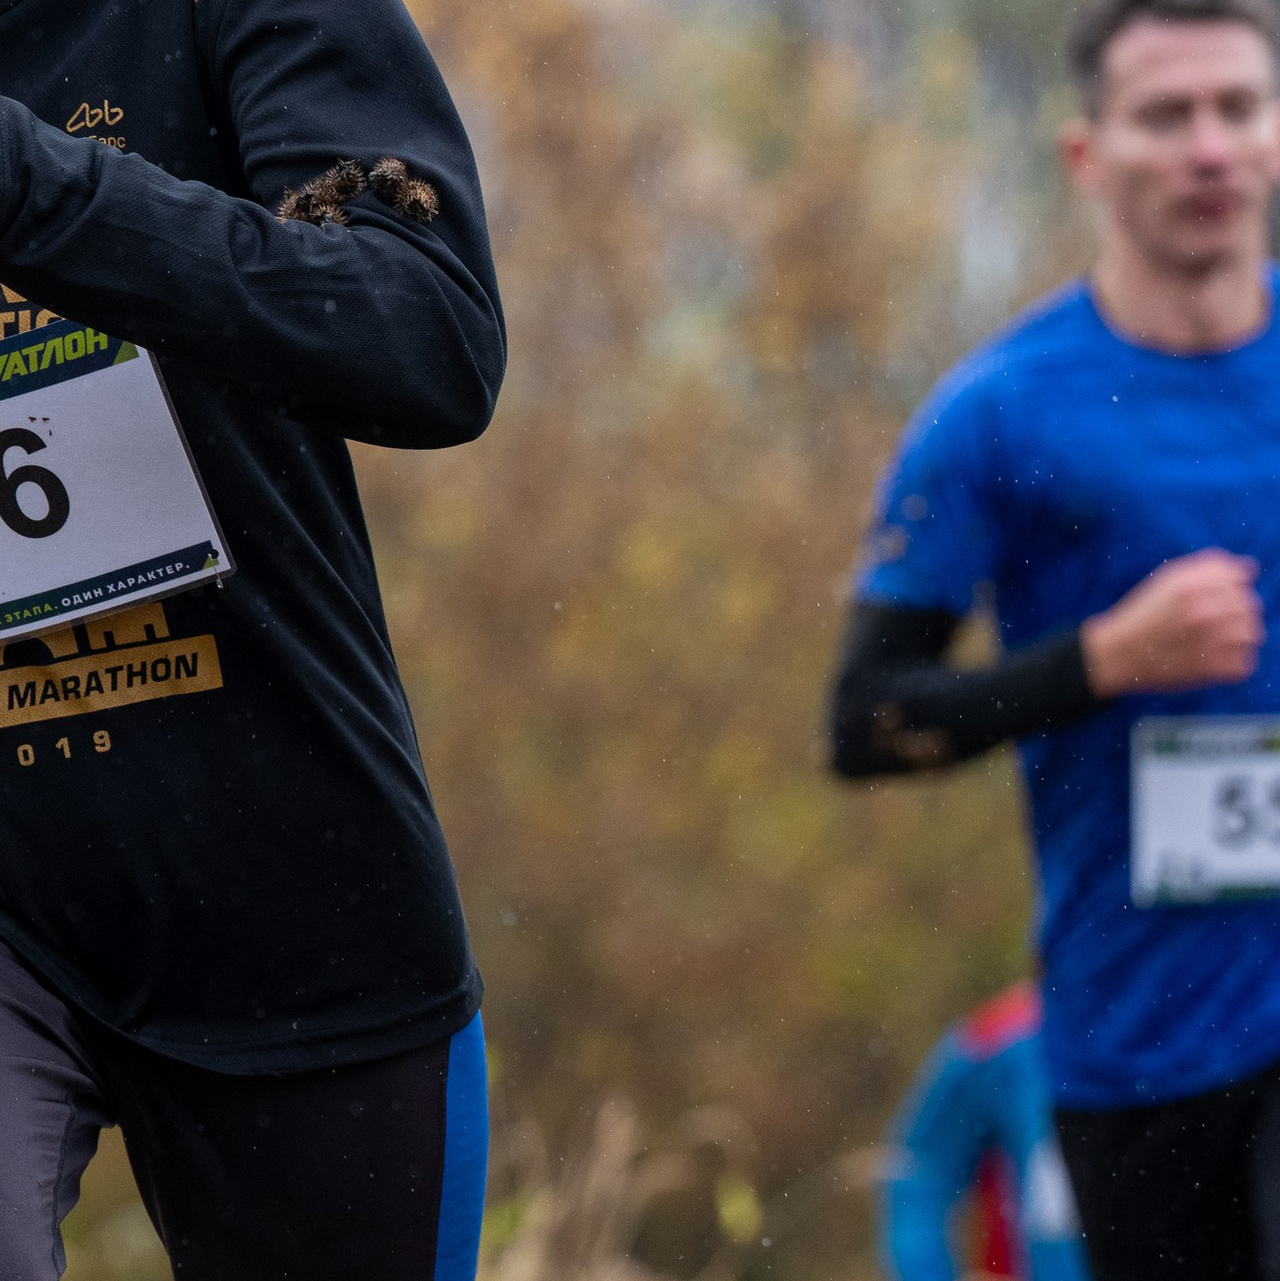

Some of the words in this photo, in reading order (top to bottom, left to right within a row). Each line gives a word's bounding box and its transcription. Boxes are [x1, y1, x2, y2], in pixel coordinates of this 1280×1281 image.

[4, 603, 59, 623] ЭТАПА.
[61, 587, 104, 607] ОДИН
[106, 562, 190, 593] ХАРАКТЕР.
[7, 652, 200, 710] MARATHON
